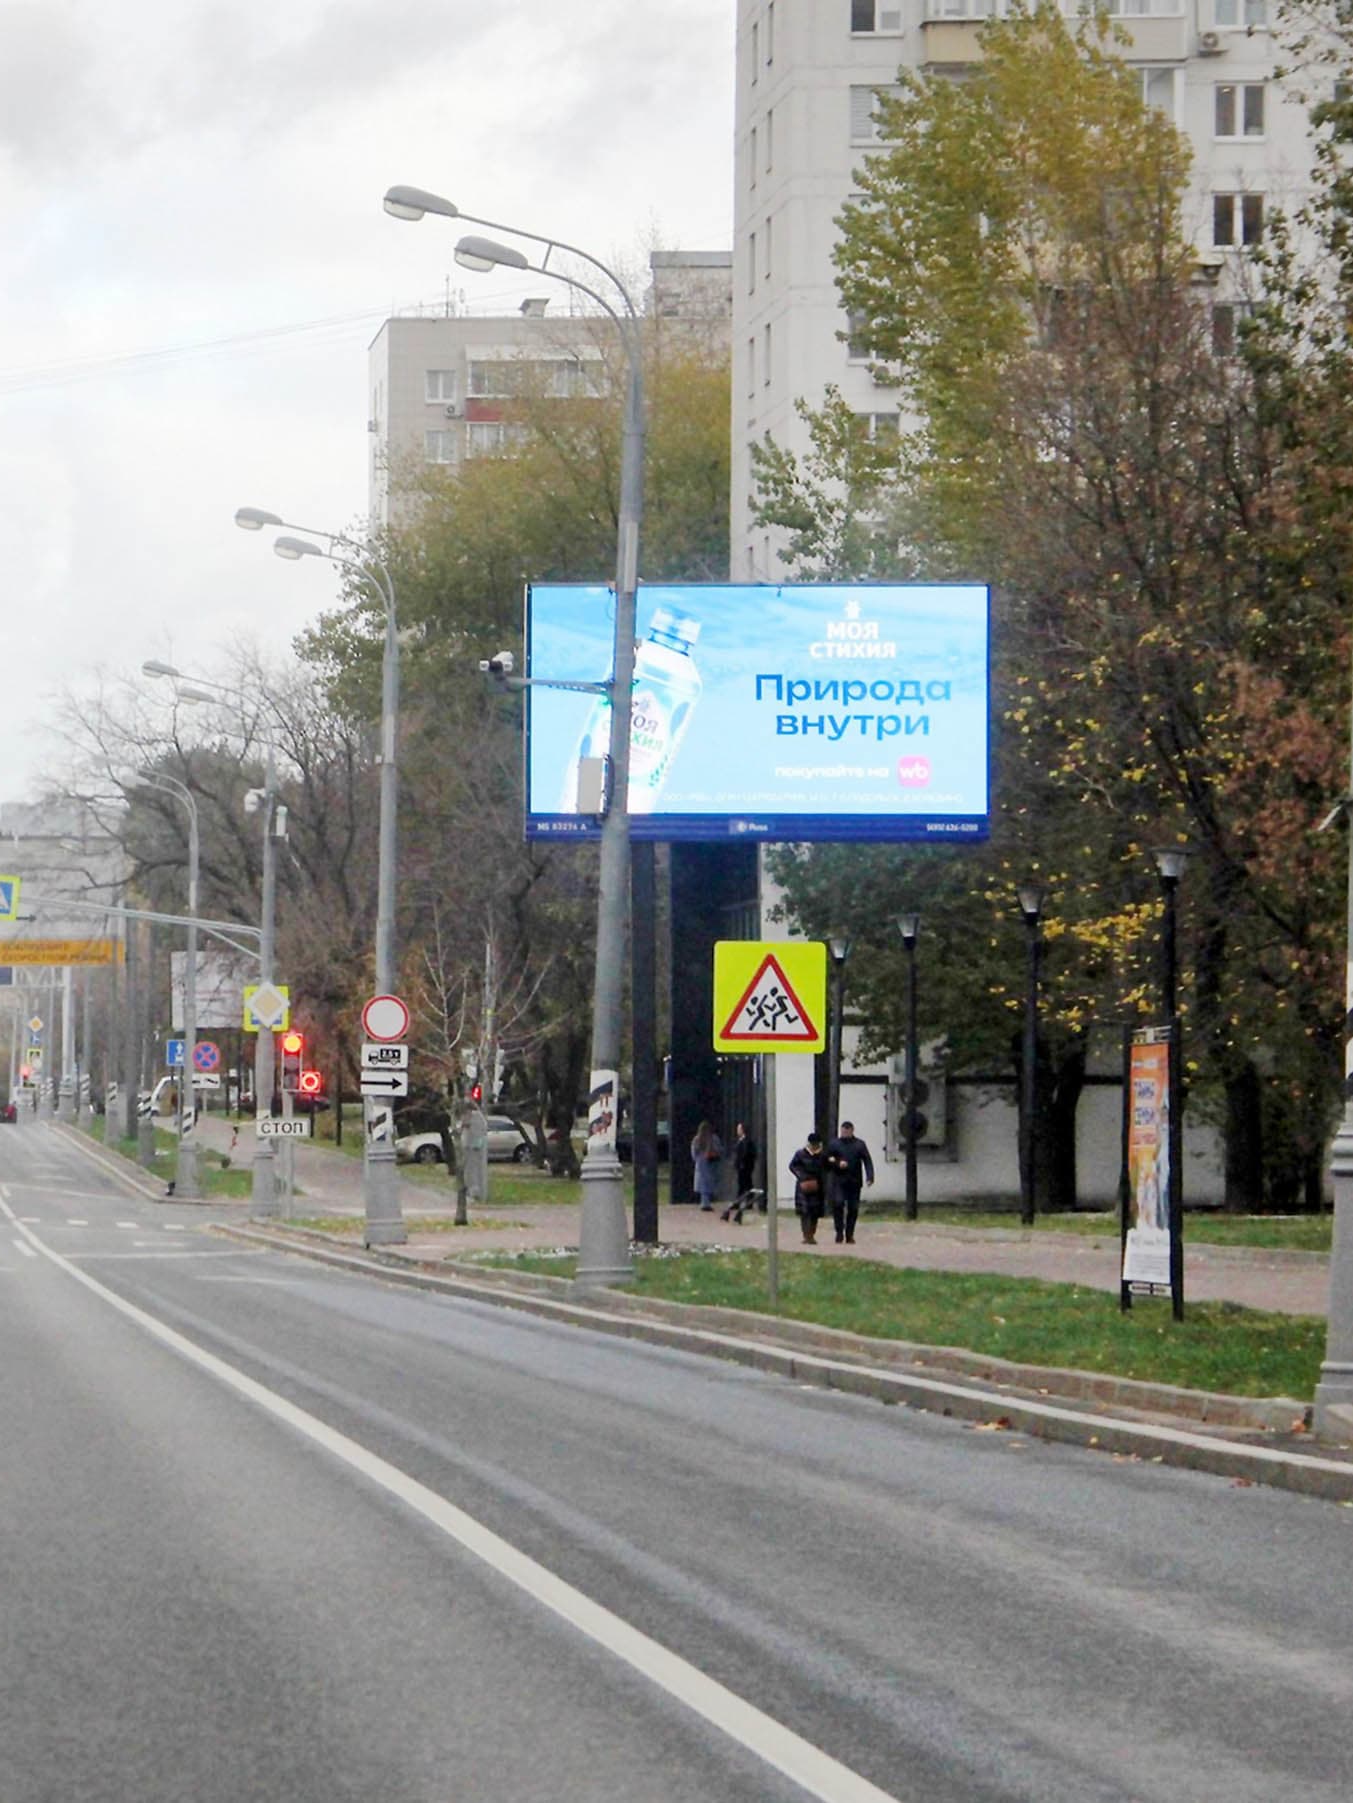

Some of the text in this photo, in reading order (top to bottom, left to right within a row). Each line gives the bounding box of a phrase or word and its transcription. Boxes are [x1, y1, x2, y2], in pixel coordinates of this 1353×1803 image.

[826, 621, 879, 640] МОЯ
[809, 641, 897, 659] СТИХИЯ
[755, 674, 952, 706] Природа
[776, 714, 930, 741] внутри
[775, 762, 889, 779] покупайте на
[899, 762, 929, 780] wb
[260, 1122, 303, 1134] СТОП
